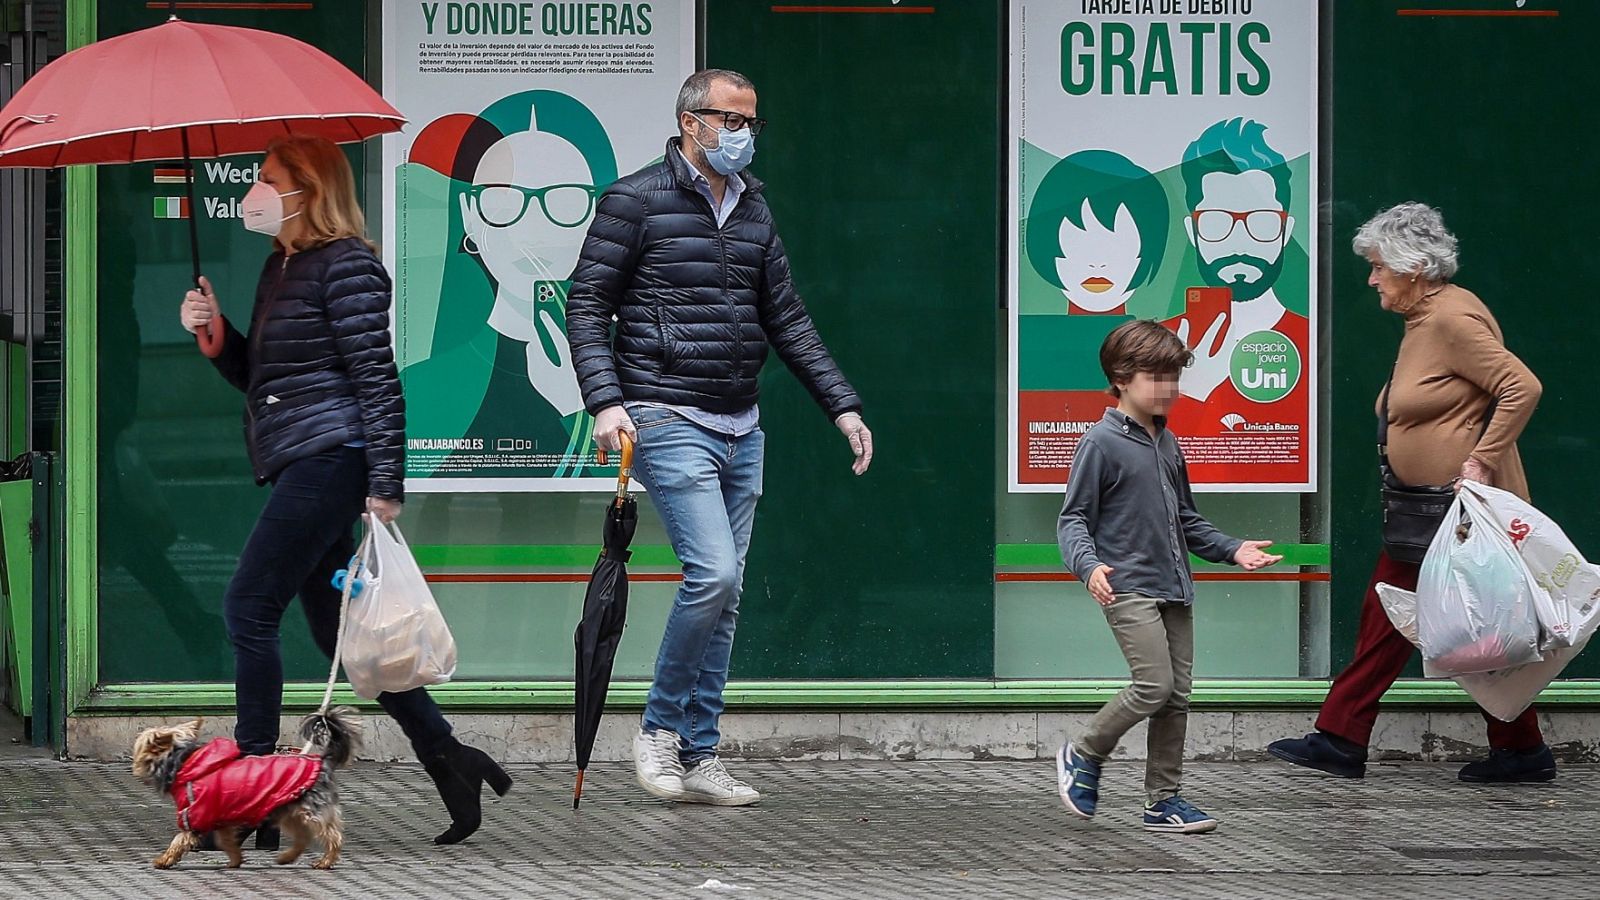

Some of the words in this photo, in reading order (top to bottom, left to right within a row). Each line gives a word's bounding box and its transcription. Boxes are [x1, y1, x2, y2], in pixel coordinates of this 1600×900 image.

[1081, 0, 1154, 14] TARJETA
[1160, 0, 1182, 14] DE
[421, 2, 439, 35] Y
[446, 2, 534, 35] DONDE
[541, 2, 652, 37] QUIERAS
[489, 43, 515, 51] depende
[462, 51, 481, 59] puede
[510, 51, 537, 59] pérdidas
[613, 51, 645, 59] posibilidad
[1060, 21, 1271, 96] GRATIS
[586, 59, 608, 67] riesgos
[465, 67, 490, 75] pasadas
[549, 67, 577, 75] fidedigno
[1241, 342, 1287, 354] espacio
[1257, 353, 1287, 365] joven
[1241, 367, 1287, 389] Uni
[1243, 422, 1274, 432] Unicaja
[1274, 423, 1299, 431] Banco
[407, 438, 484, 450] UNICAJABANCO.ES
